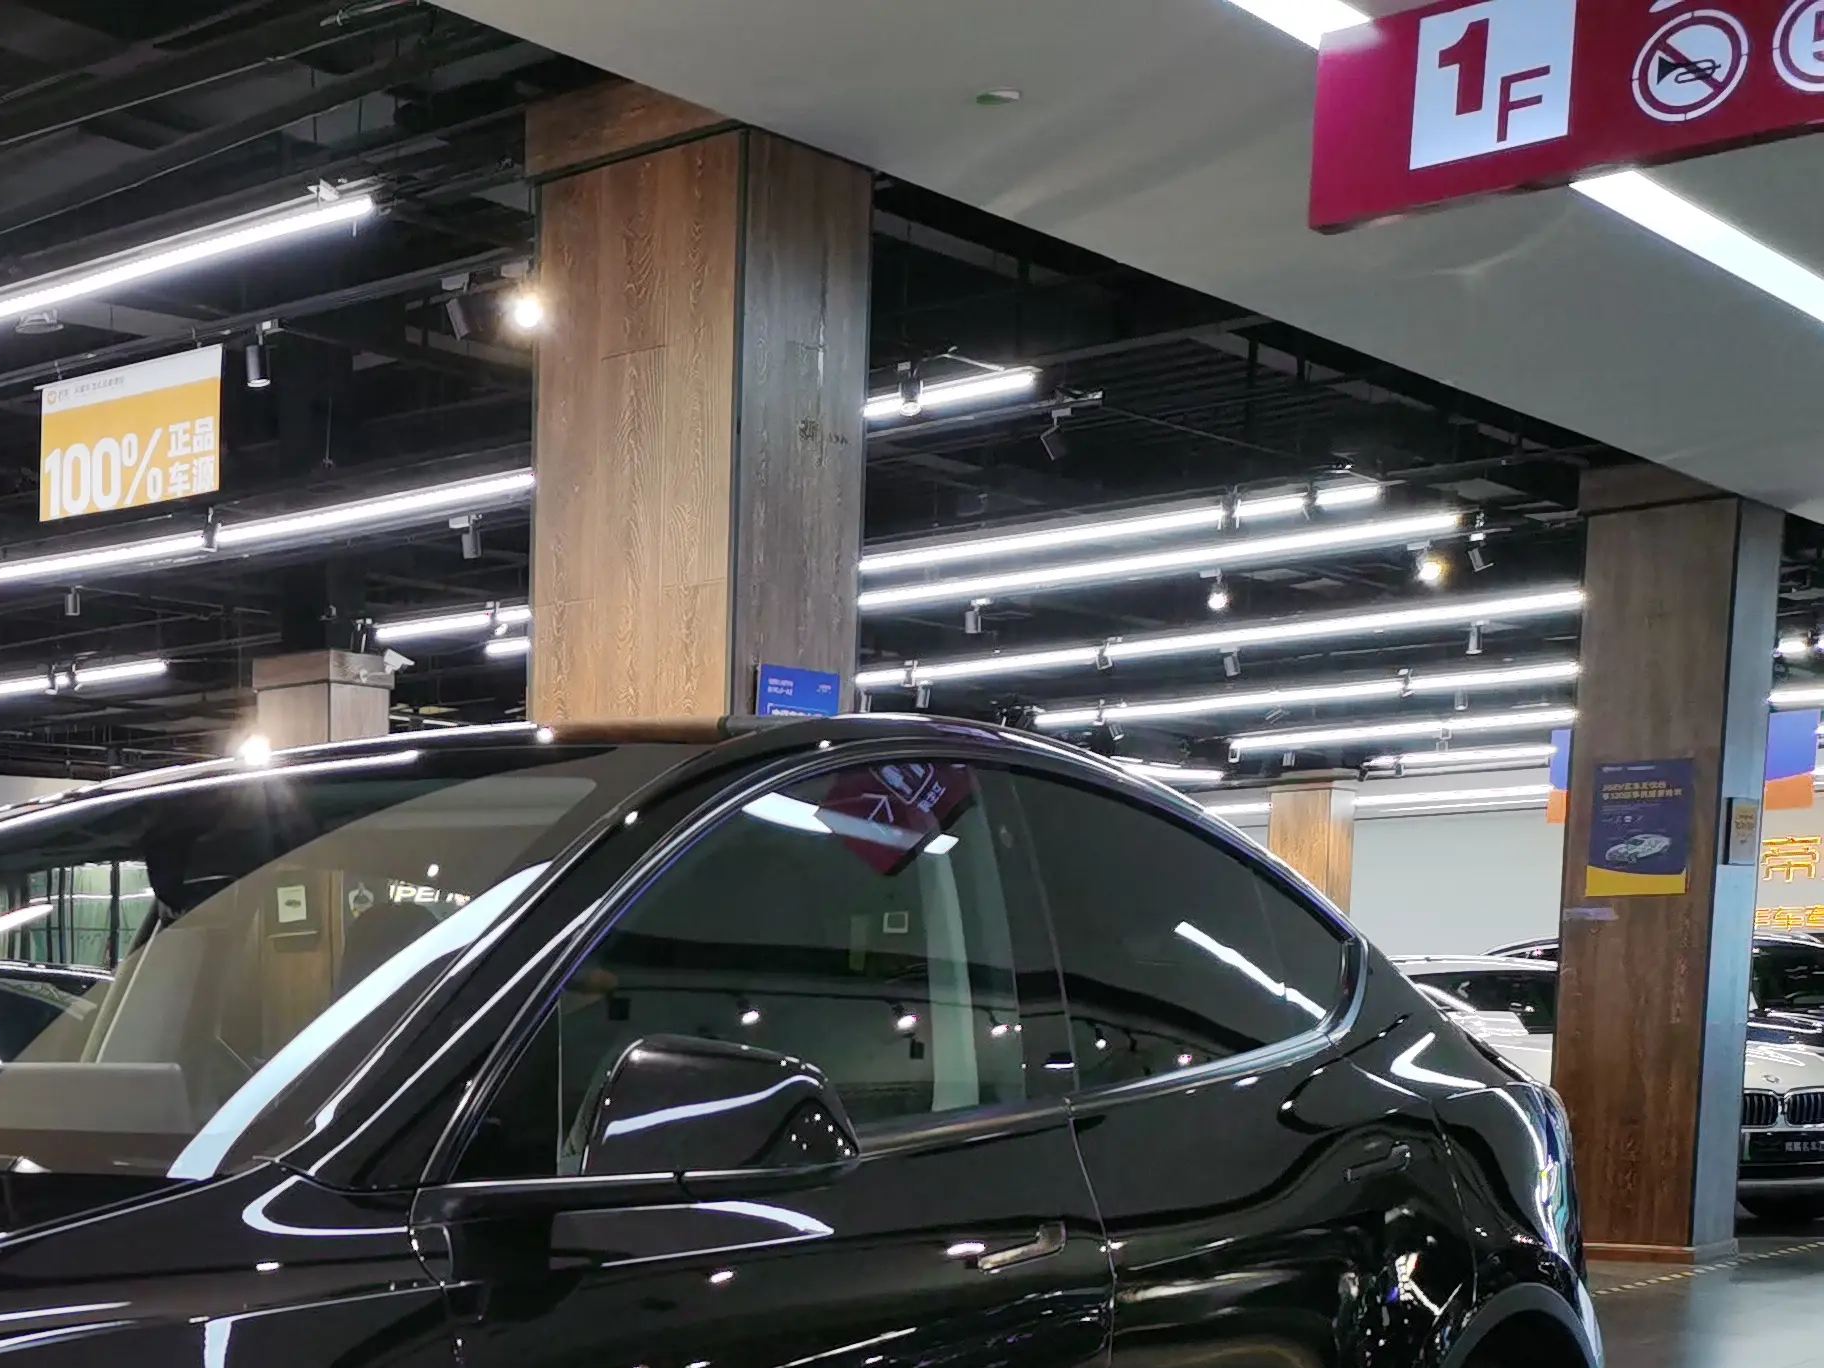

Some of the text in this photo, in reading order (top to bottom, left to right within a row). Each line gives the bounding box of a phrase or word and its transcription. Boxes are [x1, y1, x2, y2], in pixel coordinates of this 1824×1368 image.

[168, 416, 214, 458] 正品
[45, 428, 163, 519] 100%
[168, 456, 214, 498] 车源
